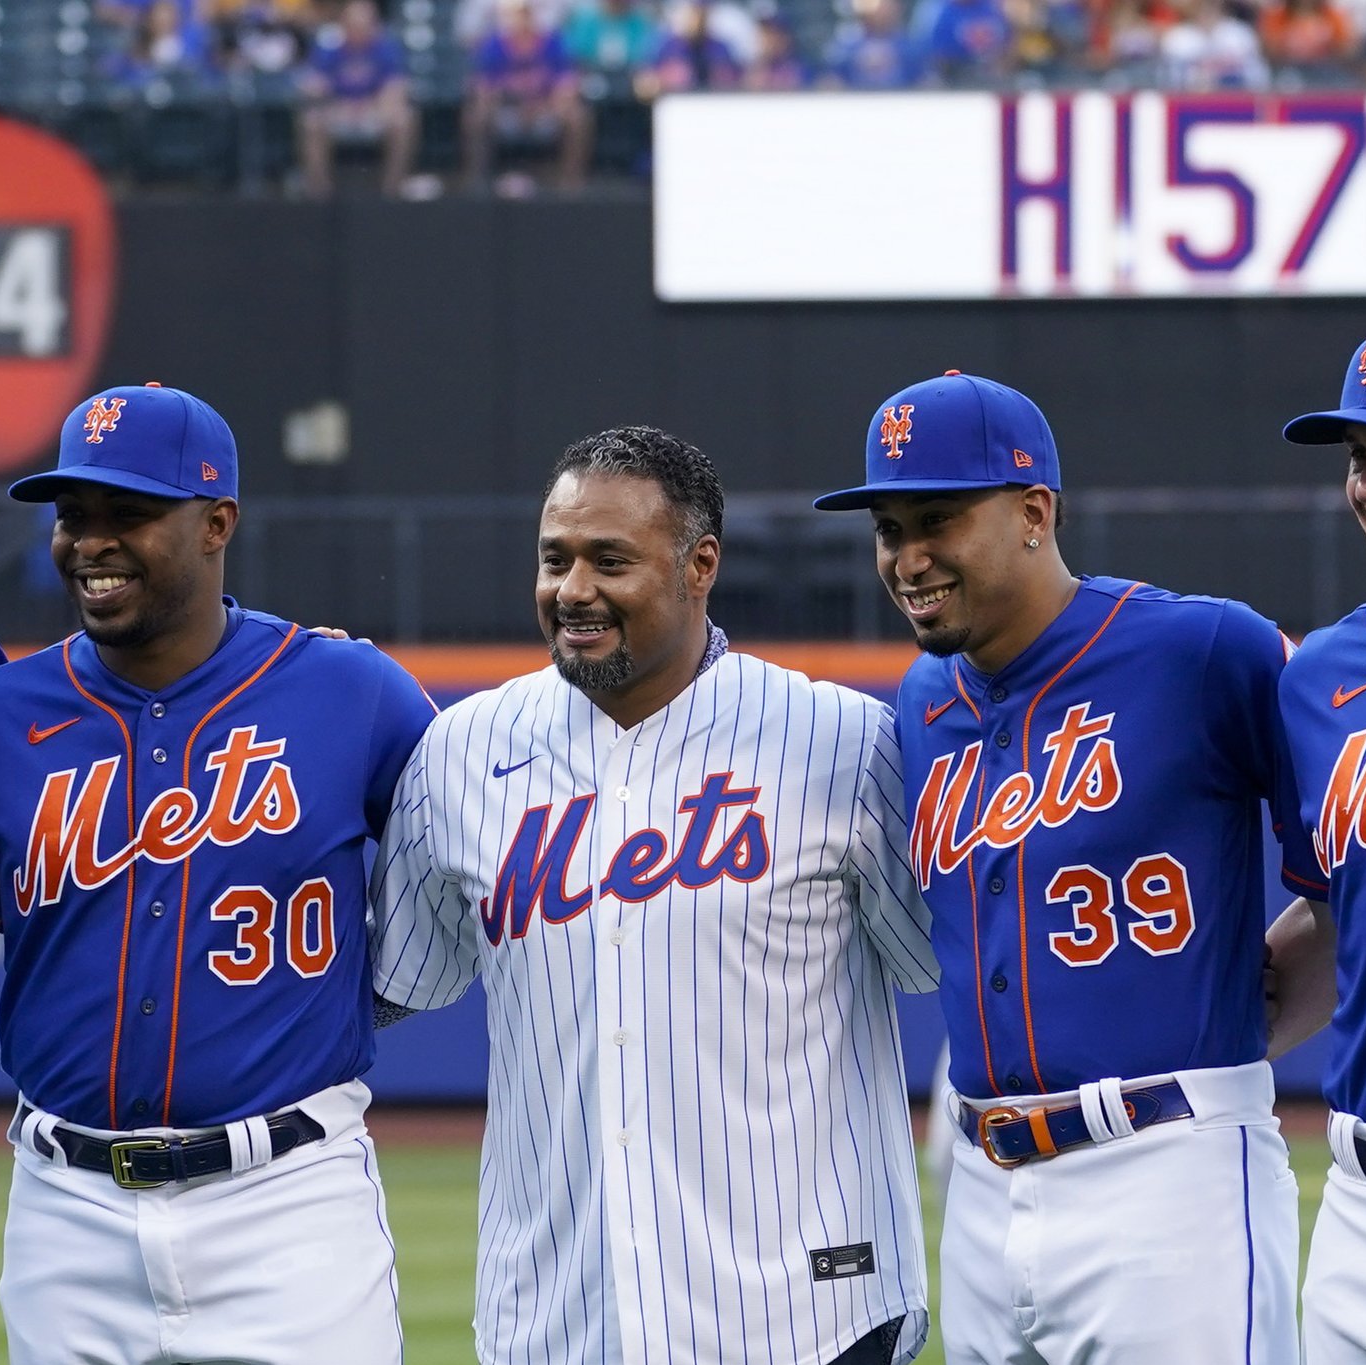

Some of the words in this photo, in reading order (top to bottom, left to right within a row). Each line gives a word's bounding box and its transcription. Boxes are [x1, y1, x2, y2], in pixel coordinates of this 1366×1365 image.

[13, 725, 301, 917] Mets
[479, 771, 771, 947] Mets
[910, 701, 1123, 892] Mets
[208, 876, 337, 986] 30
[1045, 852, 1196, 967] 39
